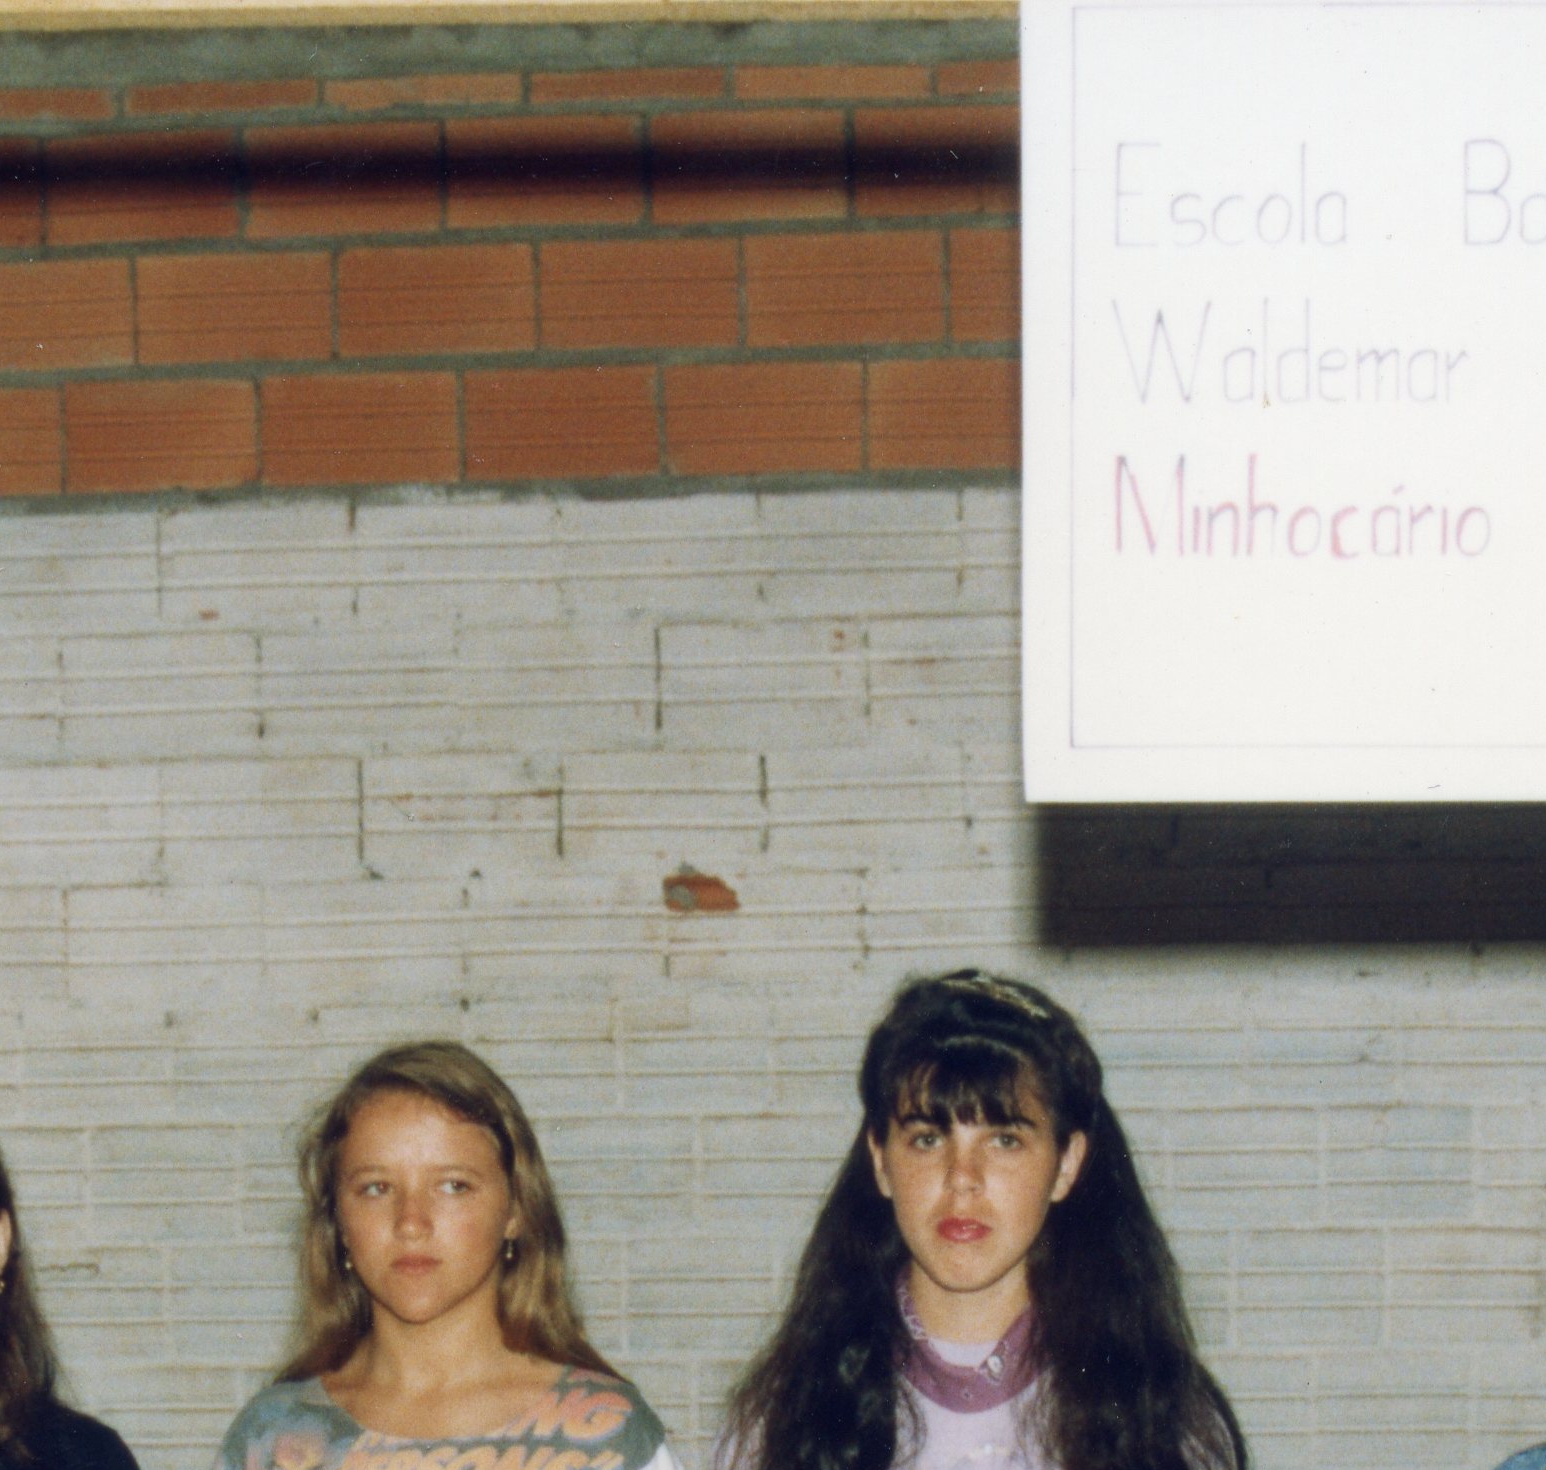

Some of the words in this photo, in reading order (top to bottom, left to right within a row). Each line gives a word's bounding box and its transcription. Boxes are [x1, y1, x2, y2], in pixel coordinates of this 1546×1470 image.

[1114, 141, 1350, 248] Escola
[1111, 297, 1471, 407] Waldemar
[1113, 453, 1494, 560] Minhocário
